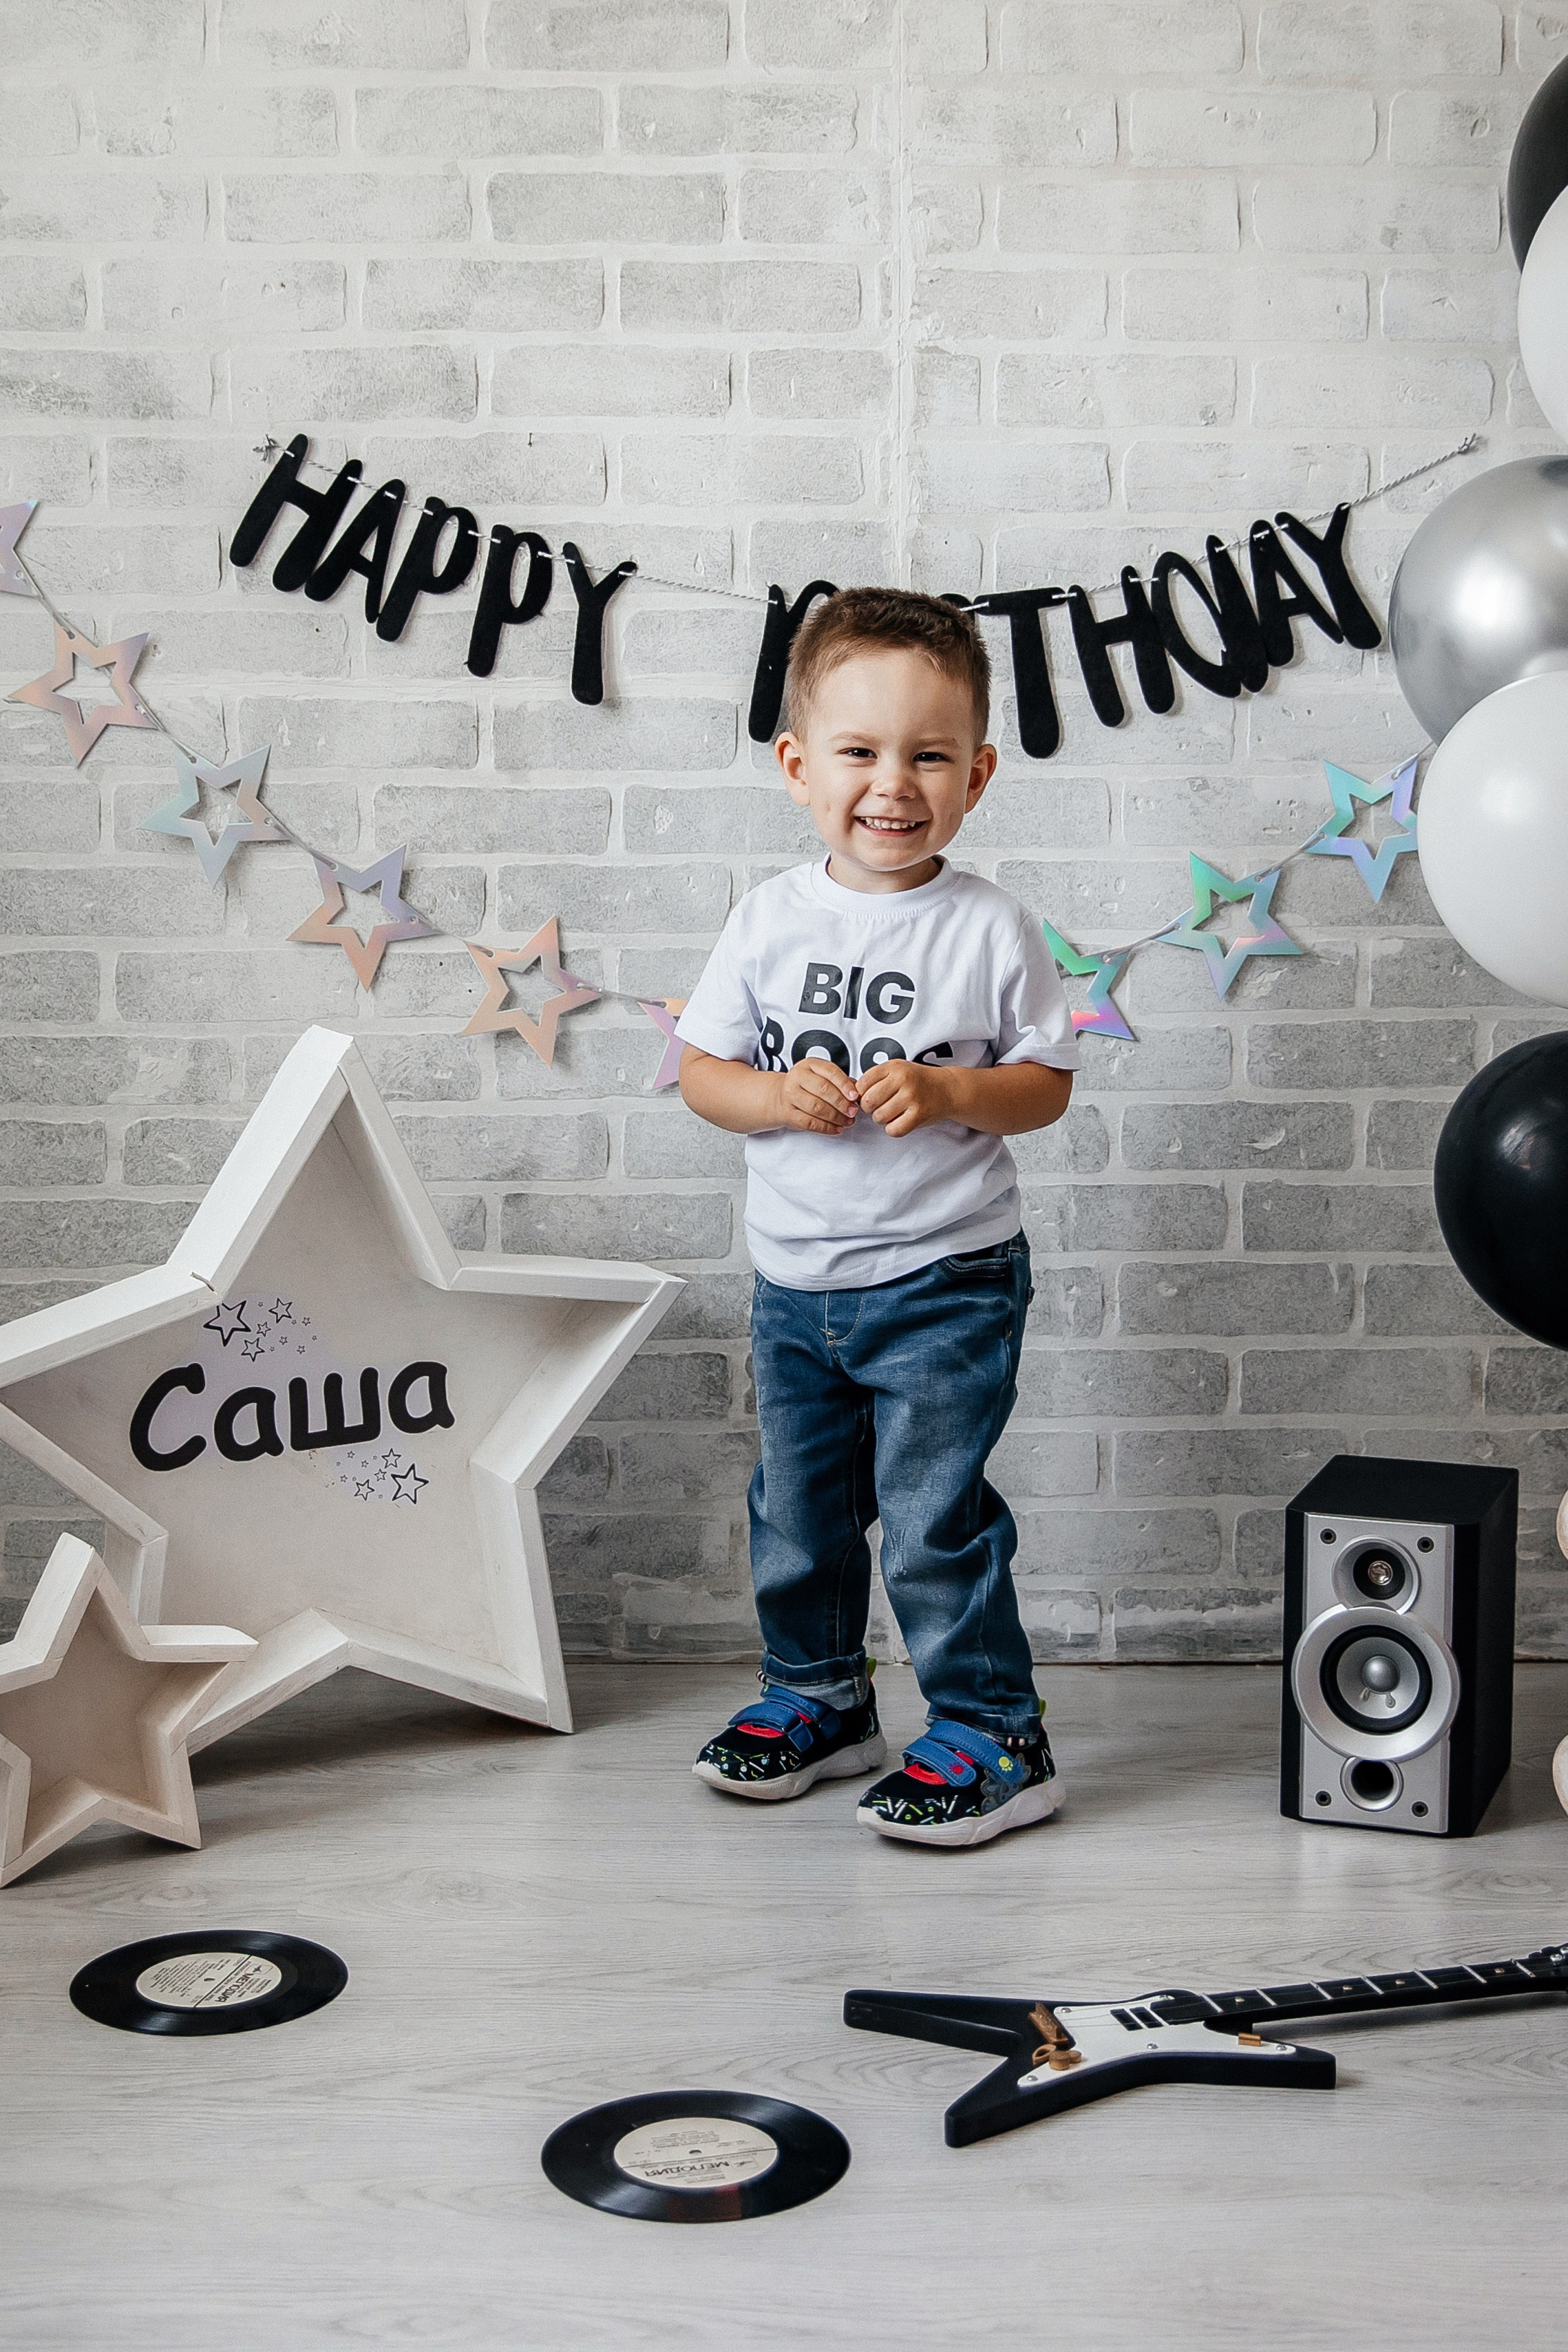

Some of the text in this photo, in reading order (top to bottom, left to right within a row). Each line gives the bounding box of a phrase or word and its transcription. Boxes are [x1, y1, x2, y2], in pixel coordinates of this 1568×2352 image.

[229, 433, 1382, 759] HAPPY THDAY
[798, 962, 915, 1024] BIG
[129, 1361, 455, 1472] Саша
[214, 1972, 254, 2003] МЕЛОДИЯ
[644, 2160, 730, 2178] МЕЛОДИЯ
